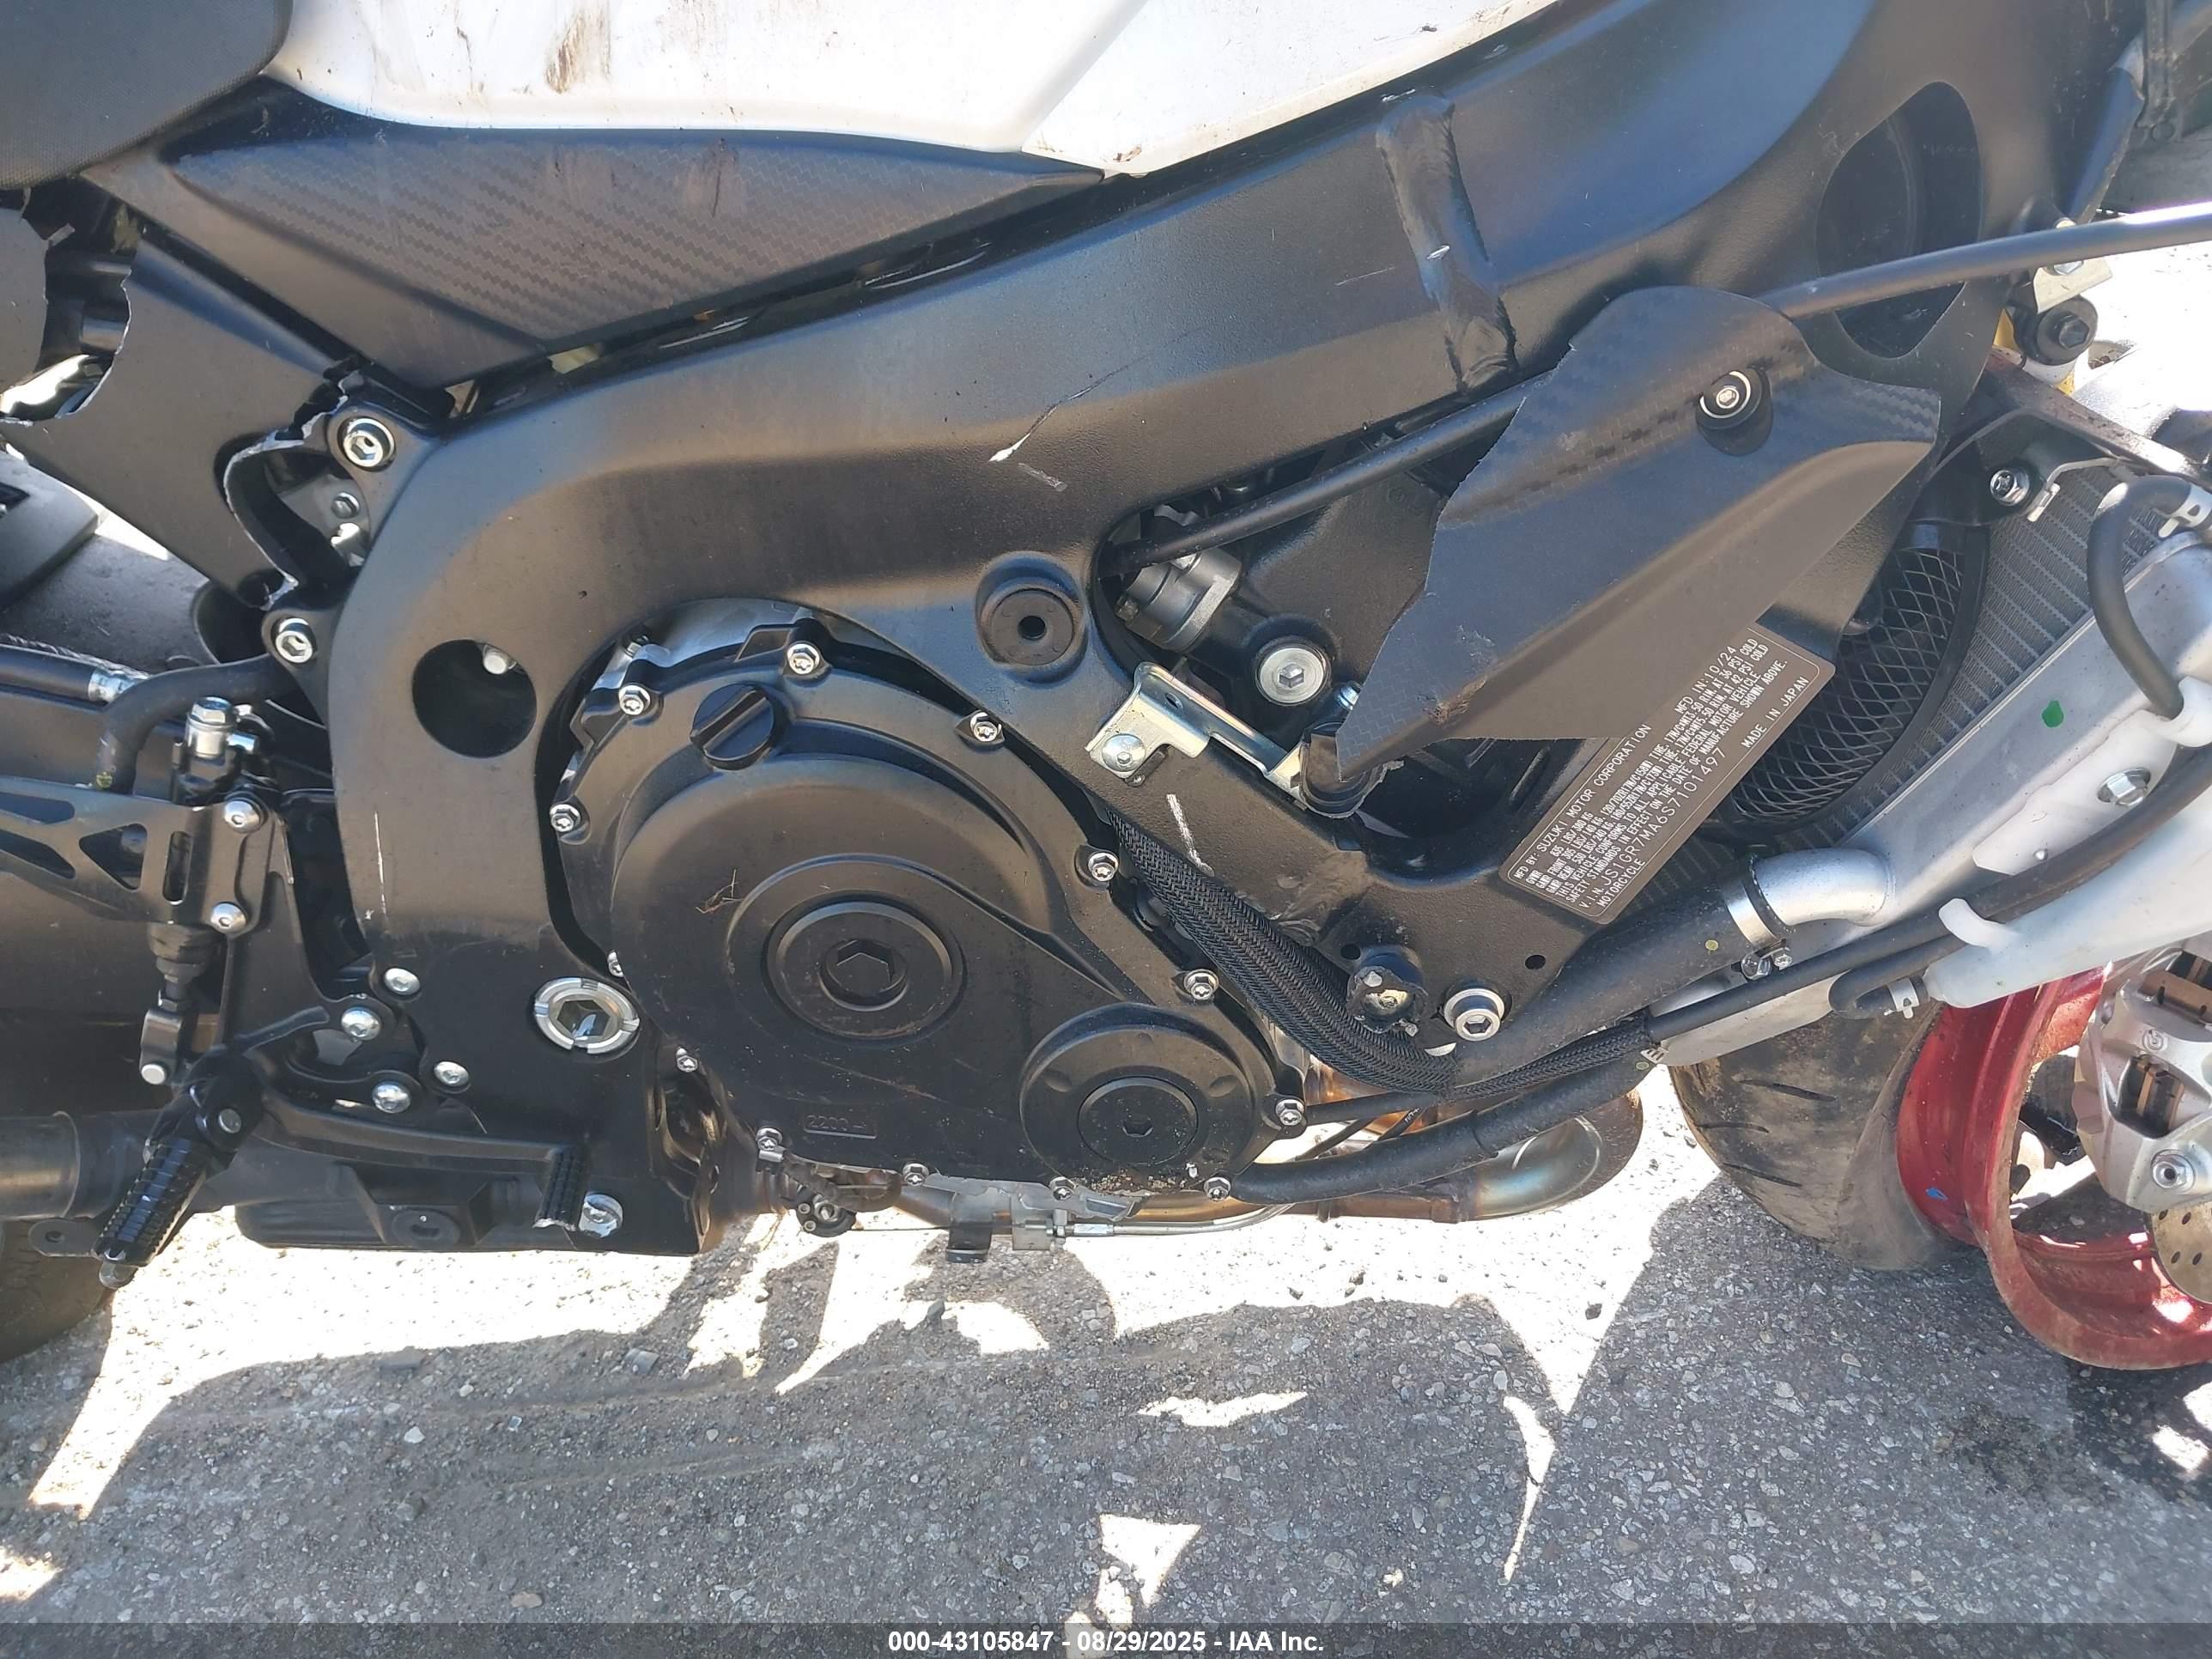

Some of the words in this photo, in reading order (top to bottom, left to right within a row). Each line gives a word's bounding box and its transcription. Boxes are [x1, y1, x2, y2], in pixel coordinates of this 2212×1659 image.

[1535, 874, 1553, 889] GAWR
[1547, 857, 1567, 876] FRONT
[1560, 847, 1577, 860] 305
[1711, 677, 1724, 690] AT
[1718, 669, 1733, 679] 36
[1727, 655, 1743, 670] PSI
[1739, 638, 1759, 656] COLD
[1545, 878, 1563, 894] GAWR
[1556, 865, 1575, 880] REAR
[1571, 852, 1587, 865] 530
[1722, 683, 1735, 695] AT
[1730, 673, 1743, 684] 42
[1737, 660, 1754, 675] PSI
[1750, 644, 1769, 661] COLD
[1674, 696, 1694, 714] MFD
[1741, 723, 1767, 748] MADE
[1765, 708, 1781, 721] IN
[1780, 676, 1809, 707] JAPAN
[1513, 866, 1528, 879] MFD
[1525, 853, 1540, 865] BY:
[1536, 820, 1568, 853] SUZUKI
[1565, 788, 1596, 818] MOTOR
[1593, 724, 1651, 787] CORPORATION
[1554, 881, 1574, 897] THIS
[1570, 854, 1599, 881] VEHICLE
[1595, 823, 1626, 854] CONFORMS
[1623, 812, 1637, 822] TO
[1632, 799, 1650, 812] ALL
[1645, 757, 1686, 798] APPLICABLE
[1680, 728, 1713, 757] FEDERAL
[1708, 702, 1734, 727] MOTOR
[1729, 670, 1761, 702] VEHICLE
[1565, 878, 1590, 903] SAFETY
[1586, 845, 1621, 879] STANDARDS
[1617, 834, 1632, 845] IN
[1626, 809, 1653, 836] EFFECT
[1649, 798, 1663, 810] ON
[1658, 784, 1676, 799] THE
[1671, 765, 1693, 785] DATE
[1688, 754, 1701, 766] OF
[1698, 708, 1744, 755] MANUFACTURE
[1739, 684, 1765, 708] SHOWN
[1760, 659, 1788, 685] ABOVE.
[1580, 811, 1594, 821] KG
[1601, 746, 1725, 886] JS1GR7MA6S7101497
[1595, 858, 1645, 908] MOTORCYCLE
